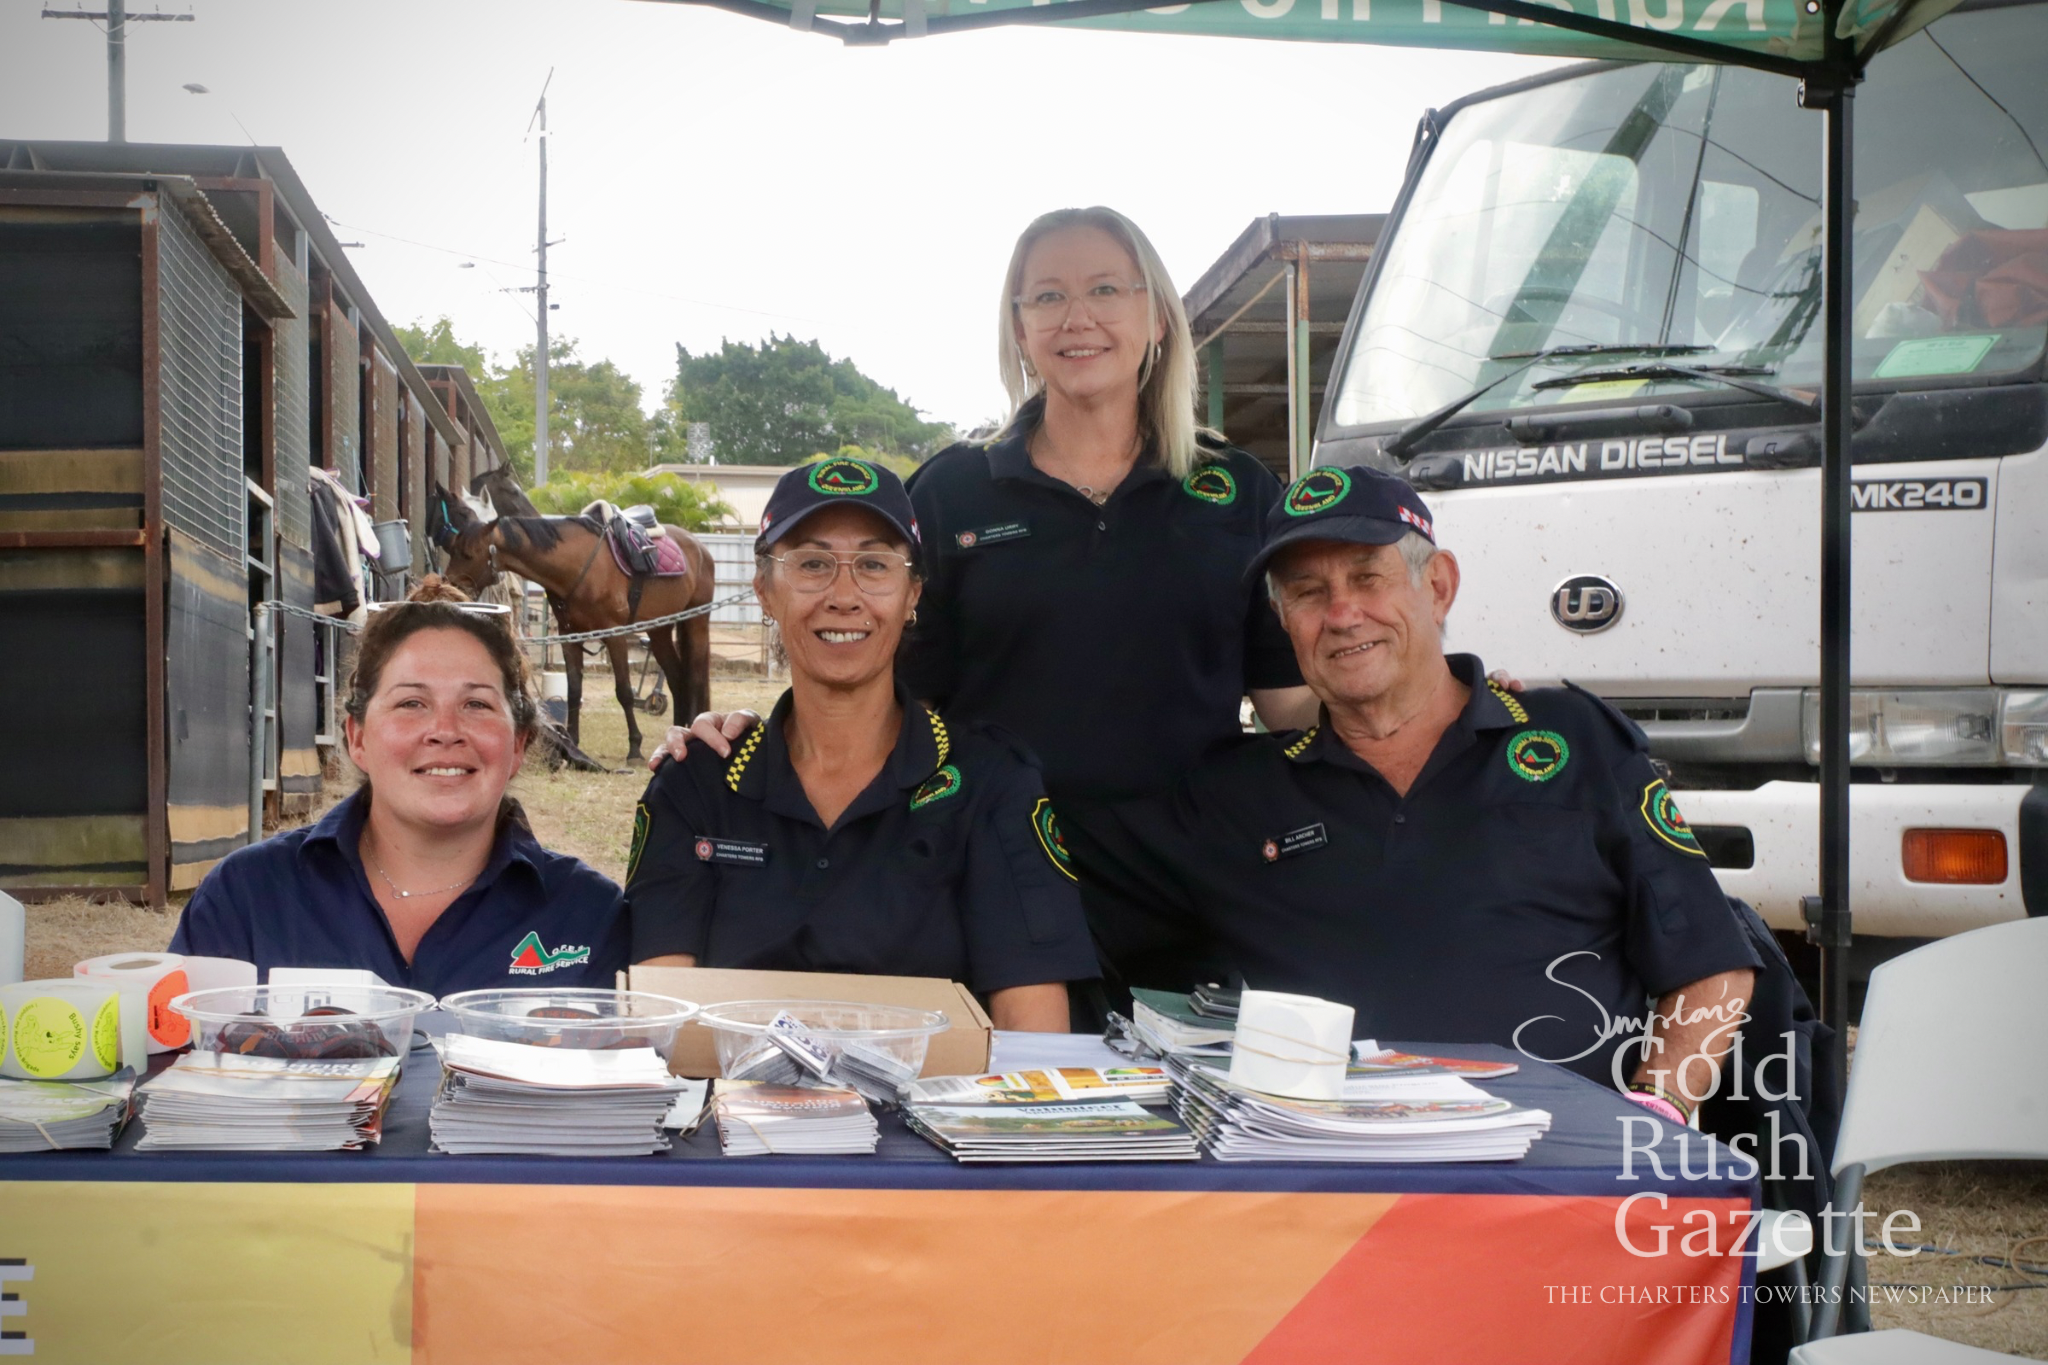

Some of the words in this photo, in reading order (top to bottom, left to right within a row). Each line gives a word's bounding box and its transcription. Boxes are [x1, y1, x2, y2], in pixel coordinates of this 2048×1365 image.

[1463, 443, 1588, 482] NISSAN
[1600, 434, 1744, 471] DIESEL
[1851, 481, 1982, 509] MK240
[1559, 586, 1615, 621] UD
[1284, 836, 1295, 844] BILL
[1295, 829, 1315, 840] ARCHER
[716, 843, 742, 852] VENESSA
[741, 846, 764, 854] PORTER
[508, 967, 537, 976] RURAL
[538, 964, 555, 975] FIRE
[555, 956, 589, 969] SERVICE
[68, 1012, 83, 1039] Bushy
[68, 1041, 82, 1060] says
[20, 1057, 40, 1073] Brigade
